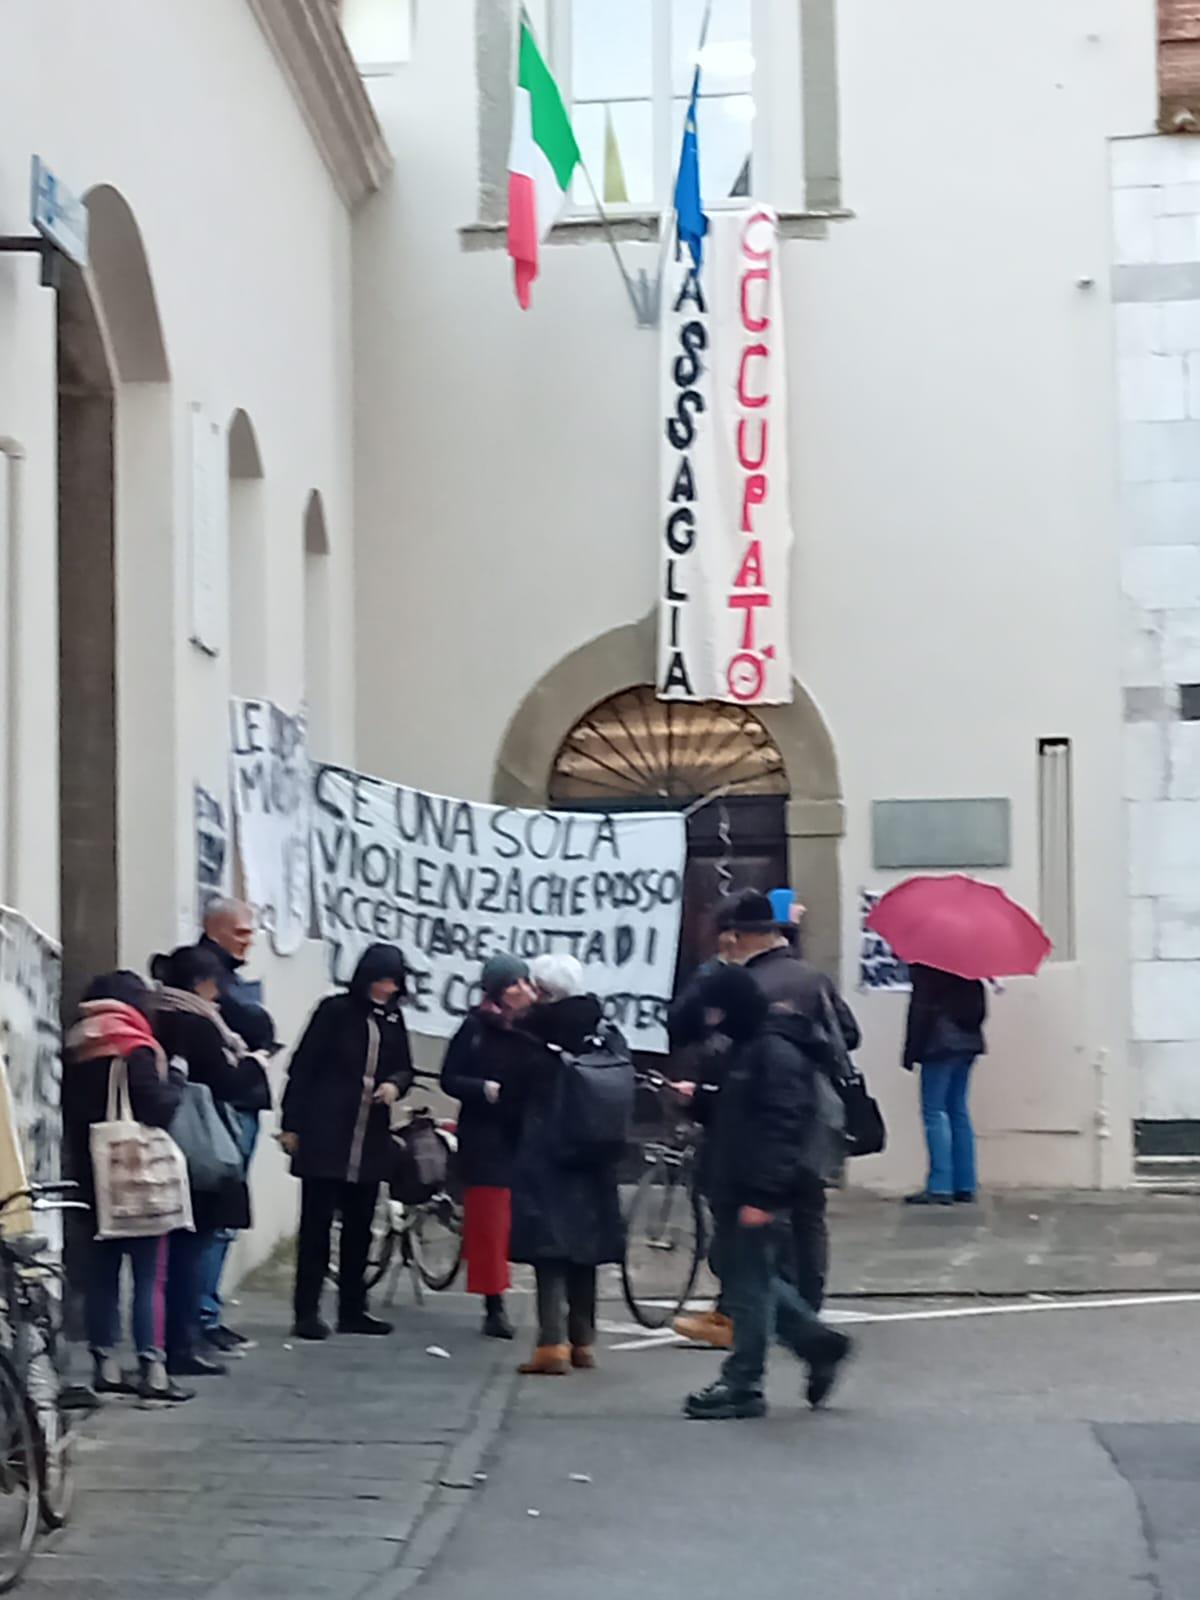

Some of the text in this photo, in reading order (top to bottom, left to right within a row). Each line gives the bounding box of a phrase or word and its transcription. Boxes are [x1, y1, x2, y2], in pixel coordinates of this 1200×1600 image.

[664, 234, 708, 696] ASSAGLIA
[396, 787, 478, 855] UNA
[490, 807, 620, 861] SOLA
[528, 872, 588, 917] CHE
[615, 923, 658, 967] DI
